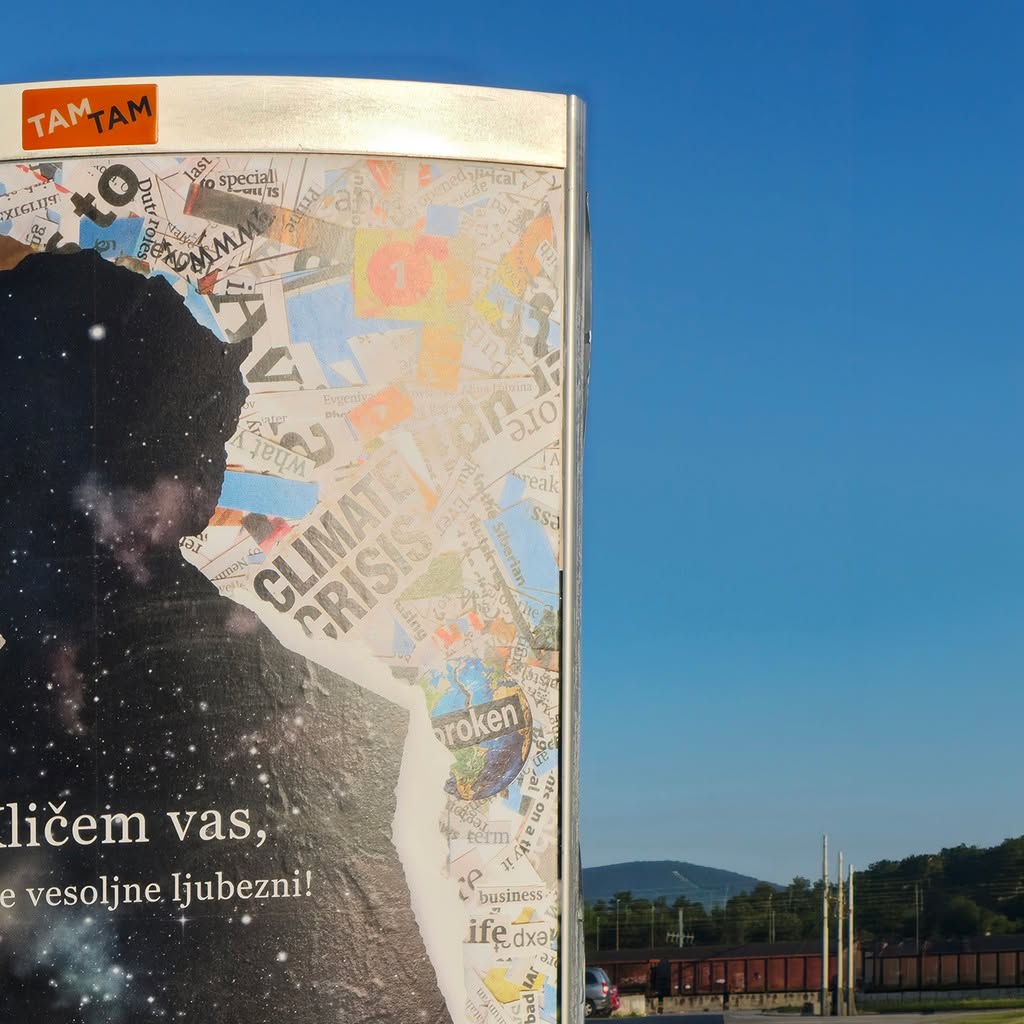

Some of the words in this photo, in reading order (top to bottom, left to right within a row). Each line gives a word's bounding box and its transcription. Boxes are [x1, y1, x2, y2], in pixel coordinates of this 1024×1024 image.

[70, 163, 139, 228] to
[218, 168, 275, 193] special
[137, 217, 159, 260] roles
[389, 260, 406, 289] 1
[253, 471, 416, 613] CLIMATE
[492, 520, 525, 587] Siberian
[166, 806, 268, 848] vas,
[26, 875, 161, 911] vesoljne
[171, 869, 313, 909] ljubezni!
[478, 888, 544, 905] business
